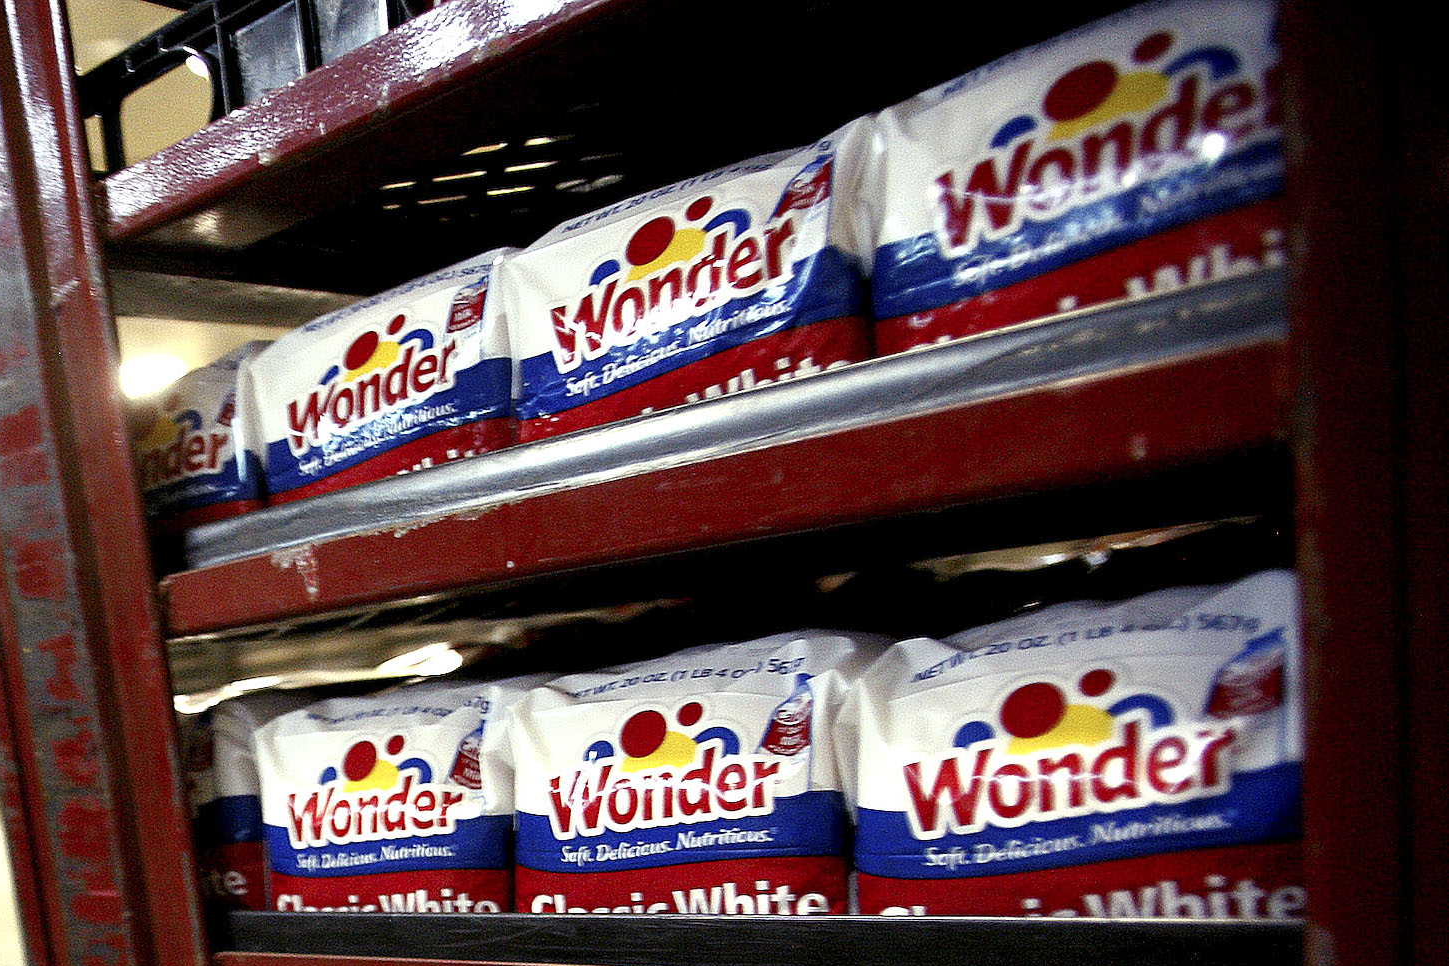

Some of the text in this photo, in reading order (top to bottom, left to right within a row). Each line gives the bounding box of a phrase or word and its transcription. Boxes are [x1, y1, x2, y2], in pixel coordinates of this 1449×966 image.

[551, 218, 794, 363] Wonder
[287, 340, 456, 448] Wonder
[643, 673, 669, 683] OZ
[691, 669, 713, 678] LB
[288, 775, 462, 842] Wonder
[549, 746, 781, 833] Wonder
[904, 721, 1235, 832] Wonder
[379, 888, 500, 912] White
[671, 880, 831, 914] White
